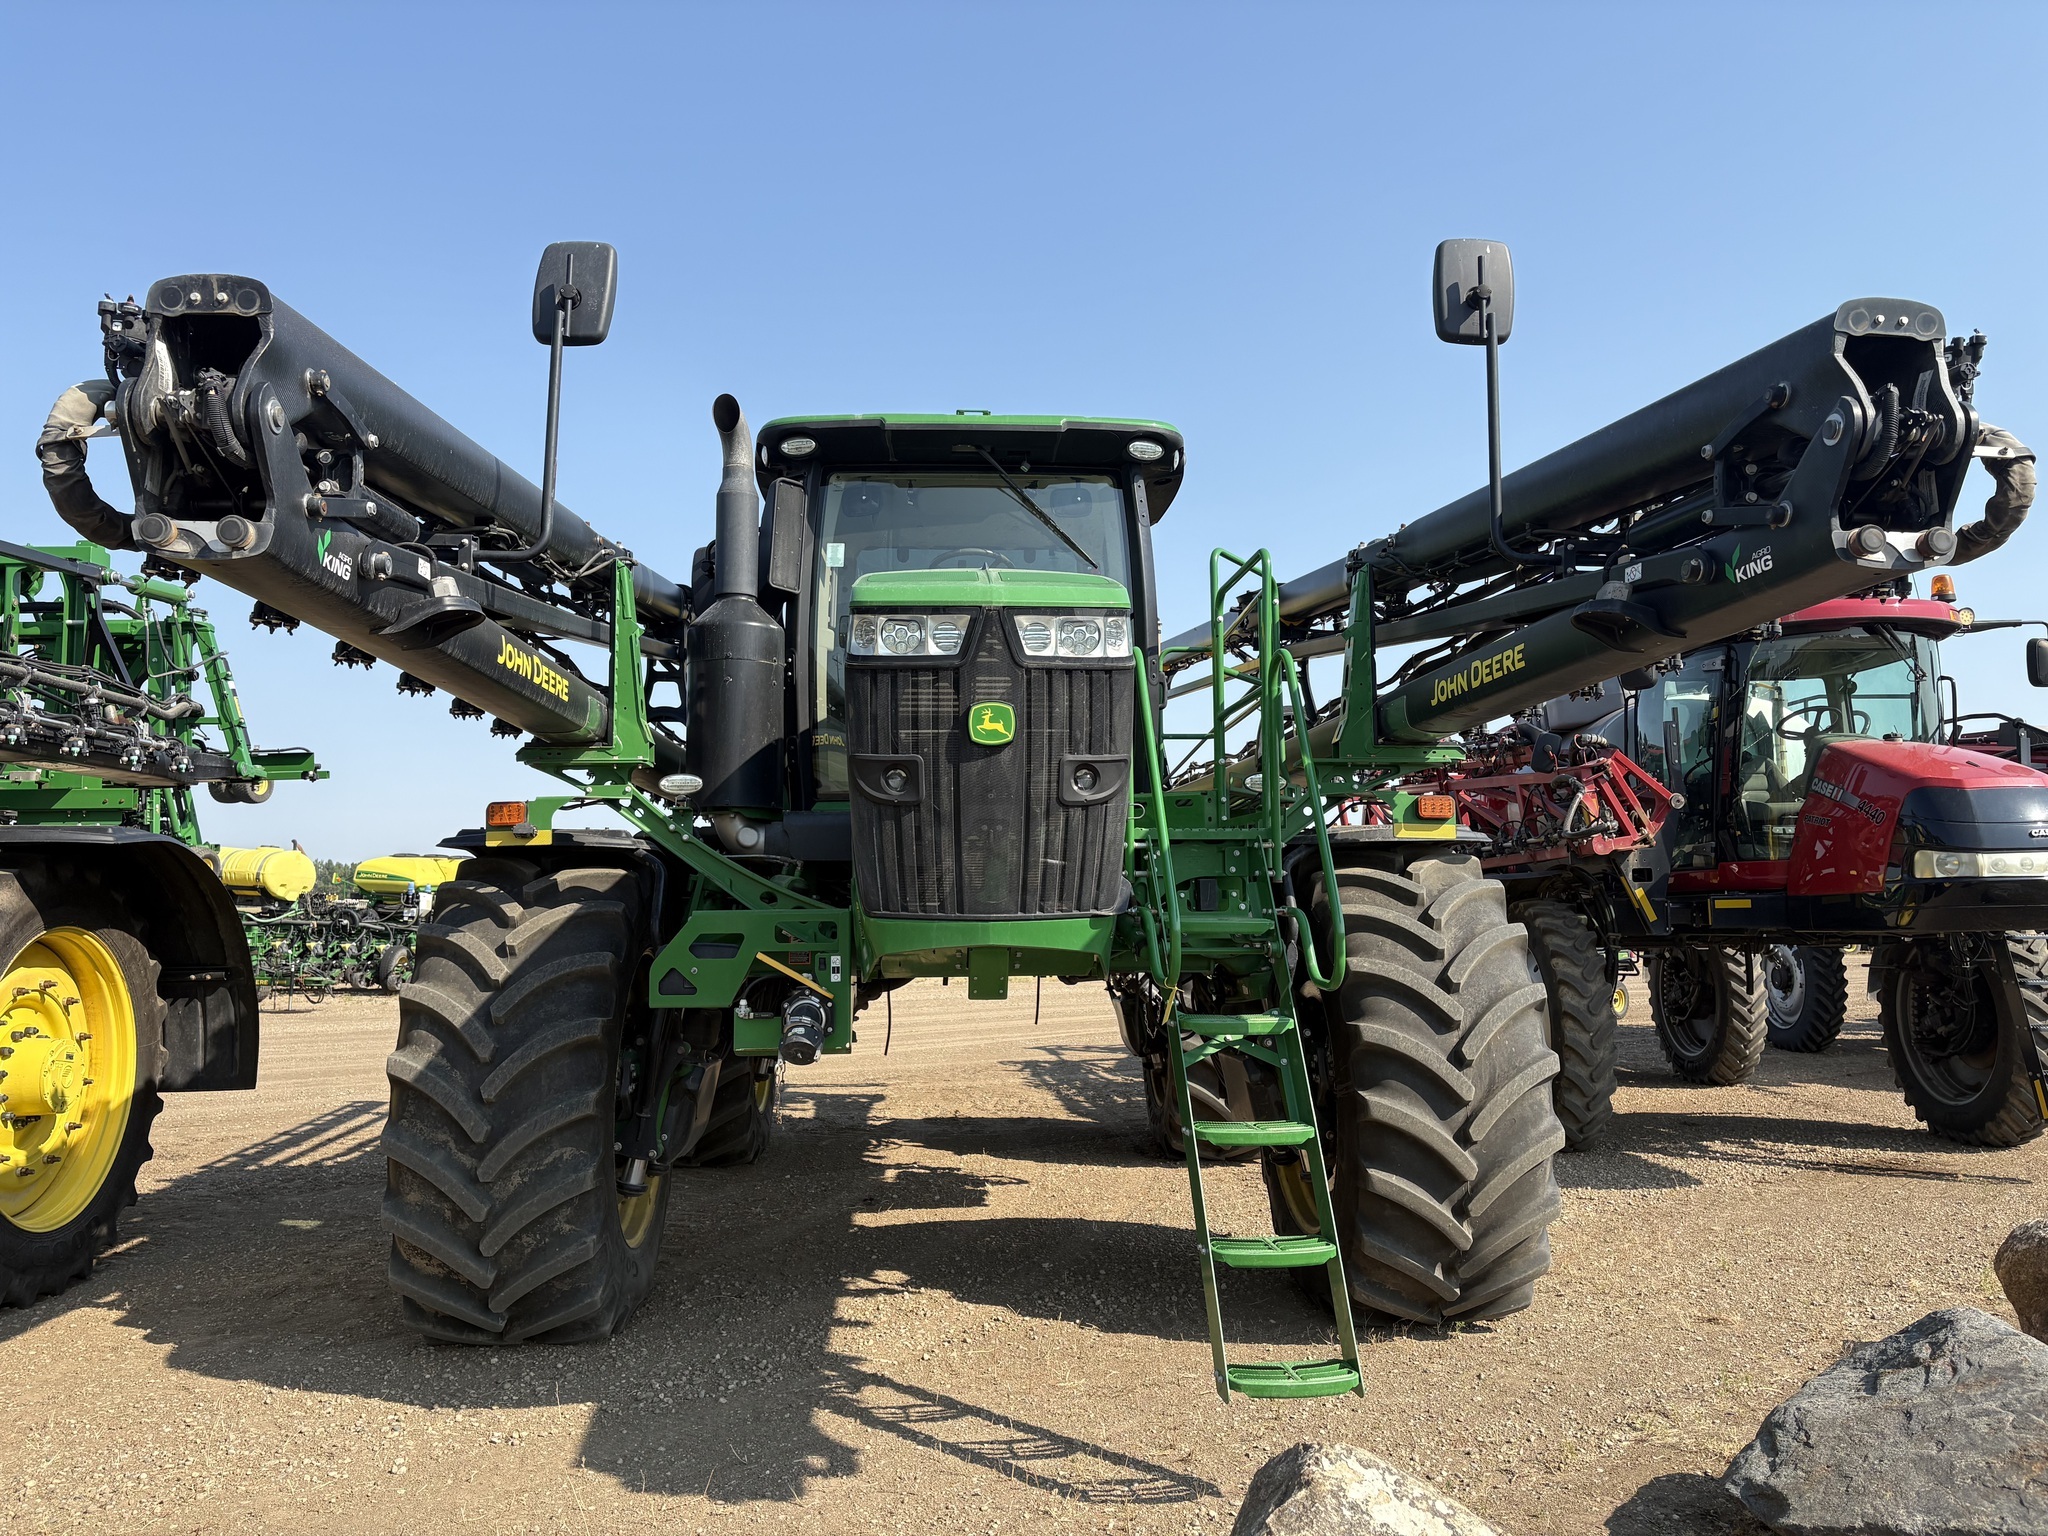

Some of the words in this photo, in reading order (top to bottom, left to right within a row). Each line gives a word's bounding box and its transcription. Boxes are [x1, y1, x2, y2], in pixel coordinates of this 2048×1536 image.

[322, 551, 352, 581] KING
[1735, 554, 1773, 583] KING
[497, 634, 532, 680] JOHN
[533, 654, 569, 702] DEERE
[1430, 667, 1468, 707] JOHN
[1470, 642, 1526, 689] DEERE
[1811, 777, 1834, 798] CASE
[1803, 814, 1832, 827] PATRIOT
[1857, 799, 1887, 826] 4440
